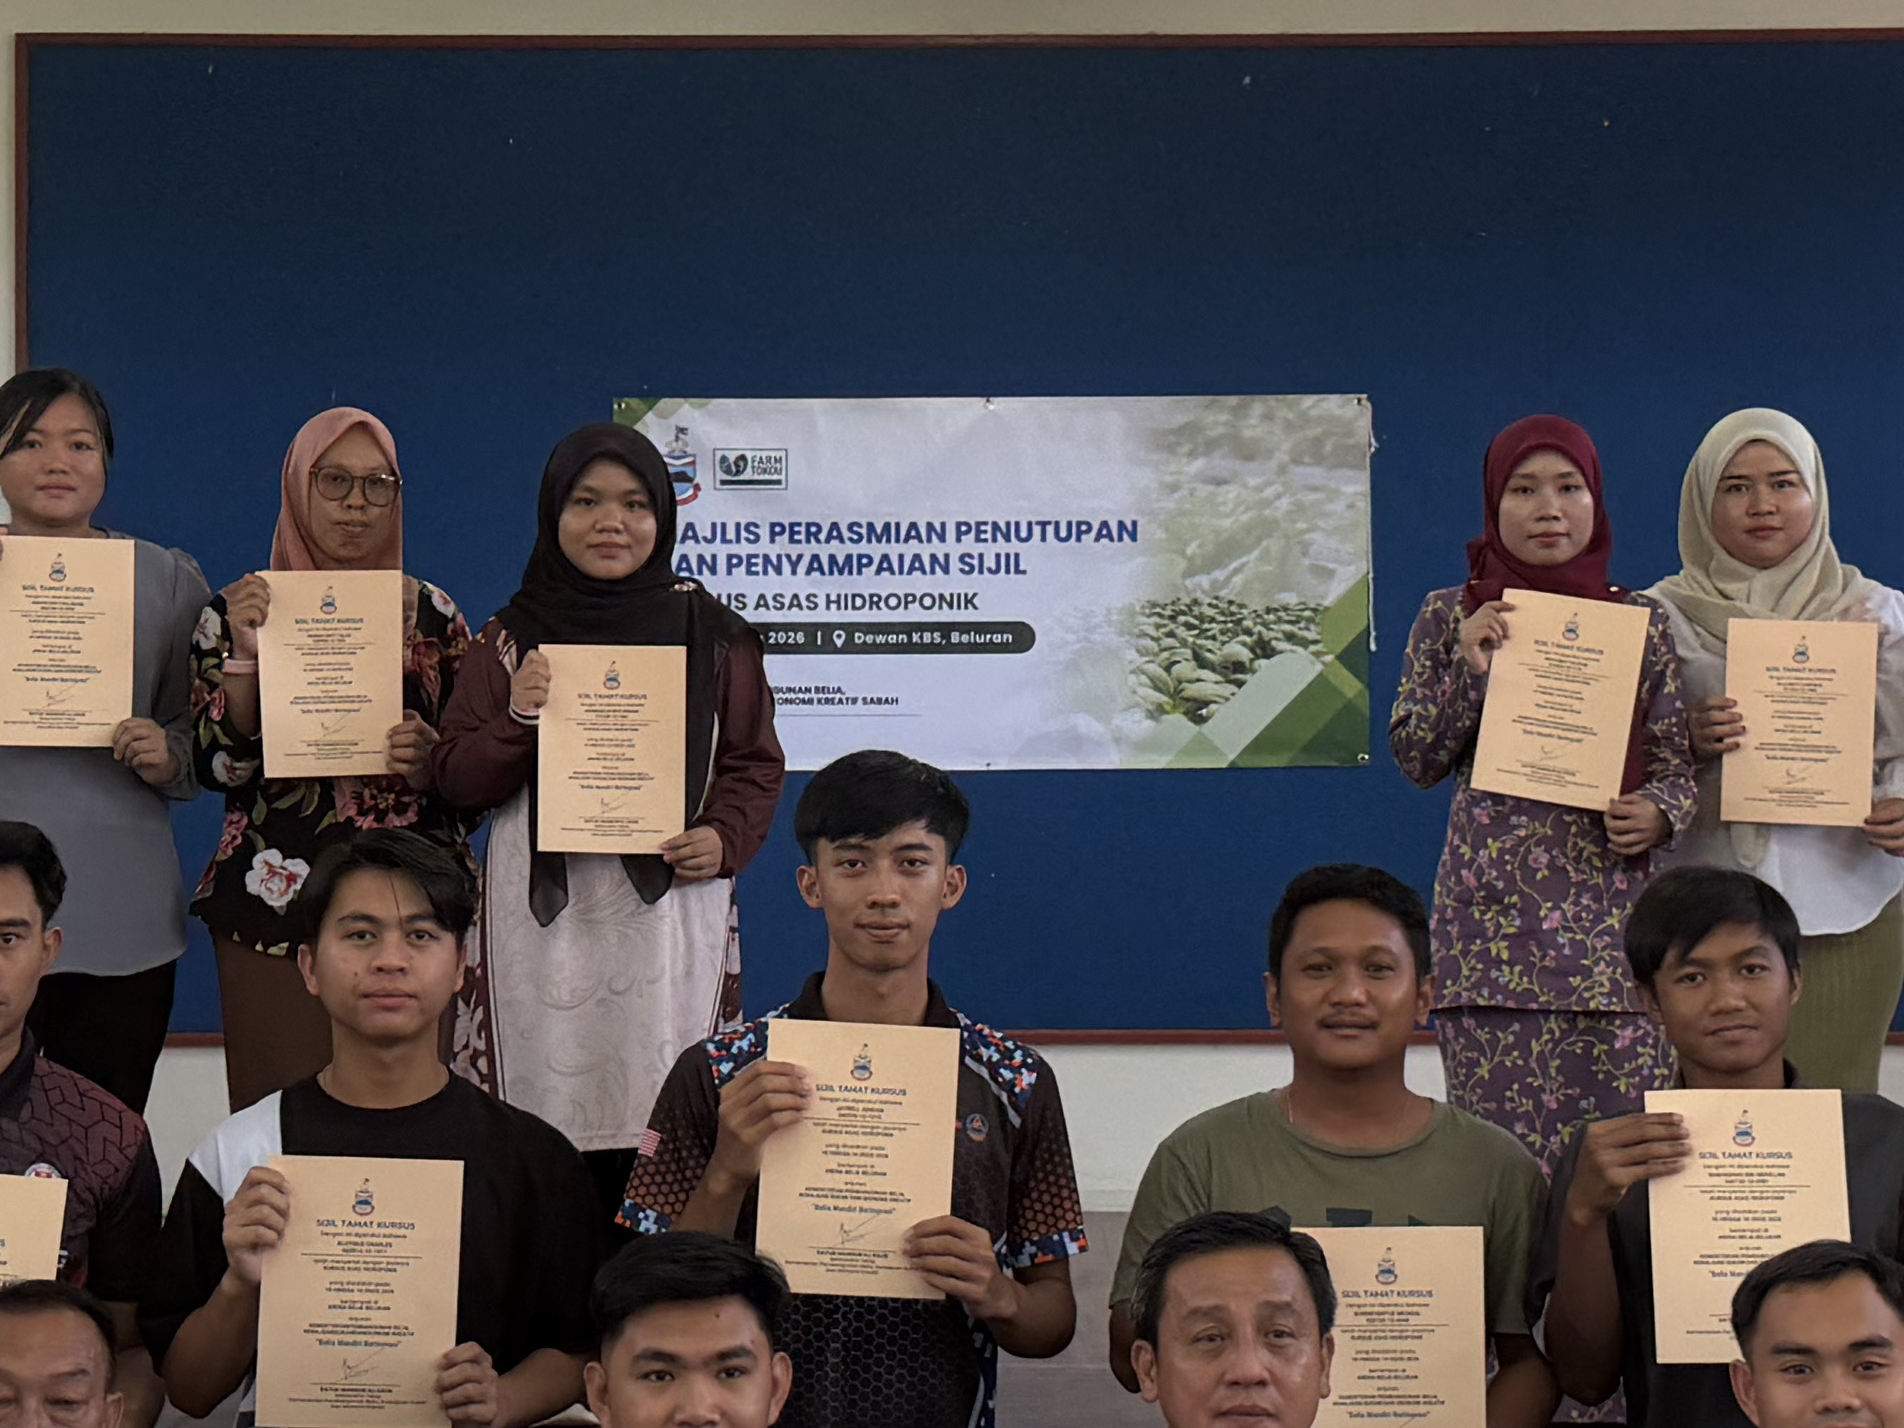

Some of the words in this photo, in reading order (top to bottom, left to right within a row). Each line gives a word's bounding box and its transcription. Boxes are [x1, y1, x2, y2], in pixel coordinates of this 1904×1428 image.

[751, 455, 783, 466] FARM
[679, 521, 761, 545] AJLIS
[768, 521, 947, 545] PERASMIAN
[956, 520, 1139, 544] PENUTUPAN
[675, 553, 717, 576] AN
[726, 553, 953, 577] PENYAMPAIAN
[958, 552, 1027, 576] SIJIL
[754, 593, 819, 611] ASAS
[825, 592, 978, 611] HIDROPONIK
[768, 632, 805, 644] 2026
[854, 632, 908, 644] Dewan
[912, 632, 946, 646] KBS,
[951, 631, 1013, 644] Beluran
[776, 697, 815, 706] ONOMI
[862, 697, 899, 706] SABAH
